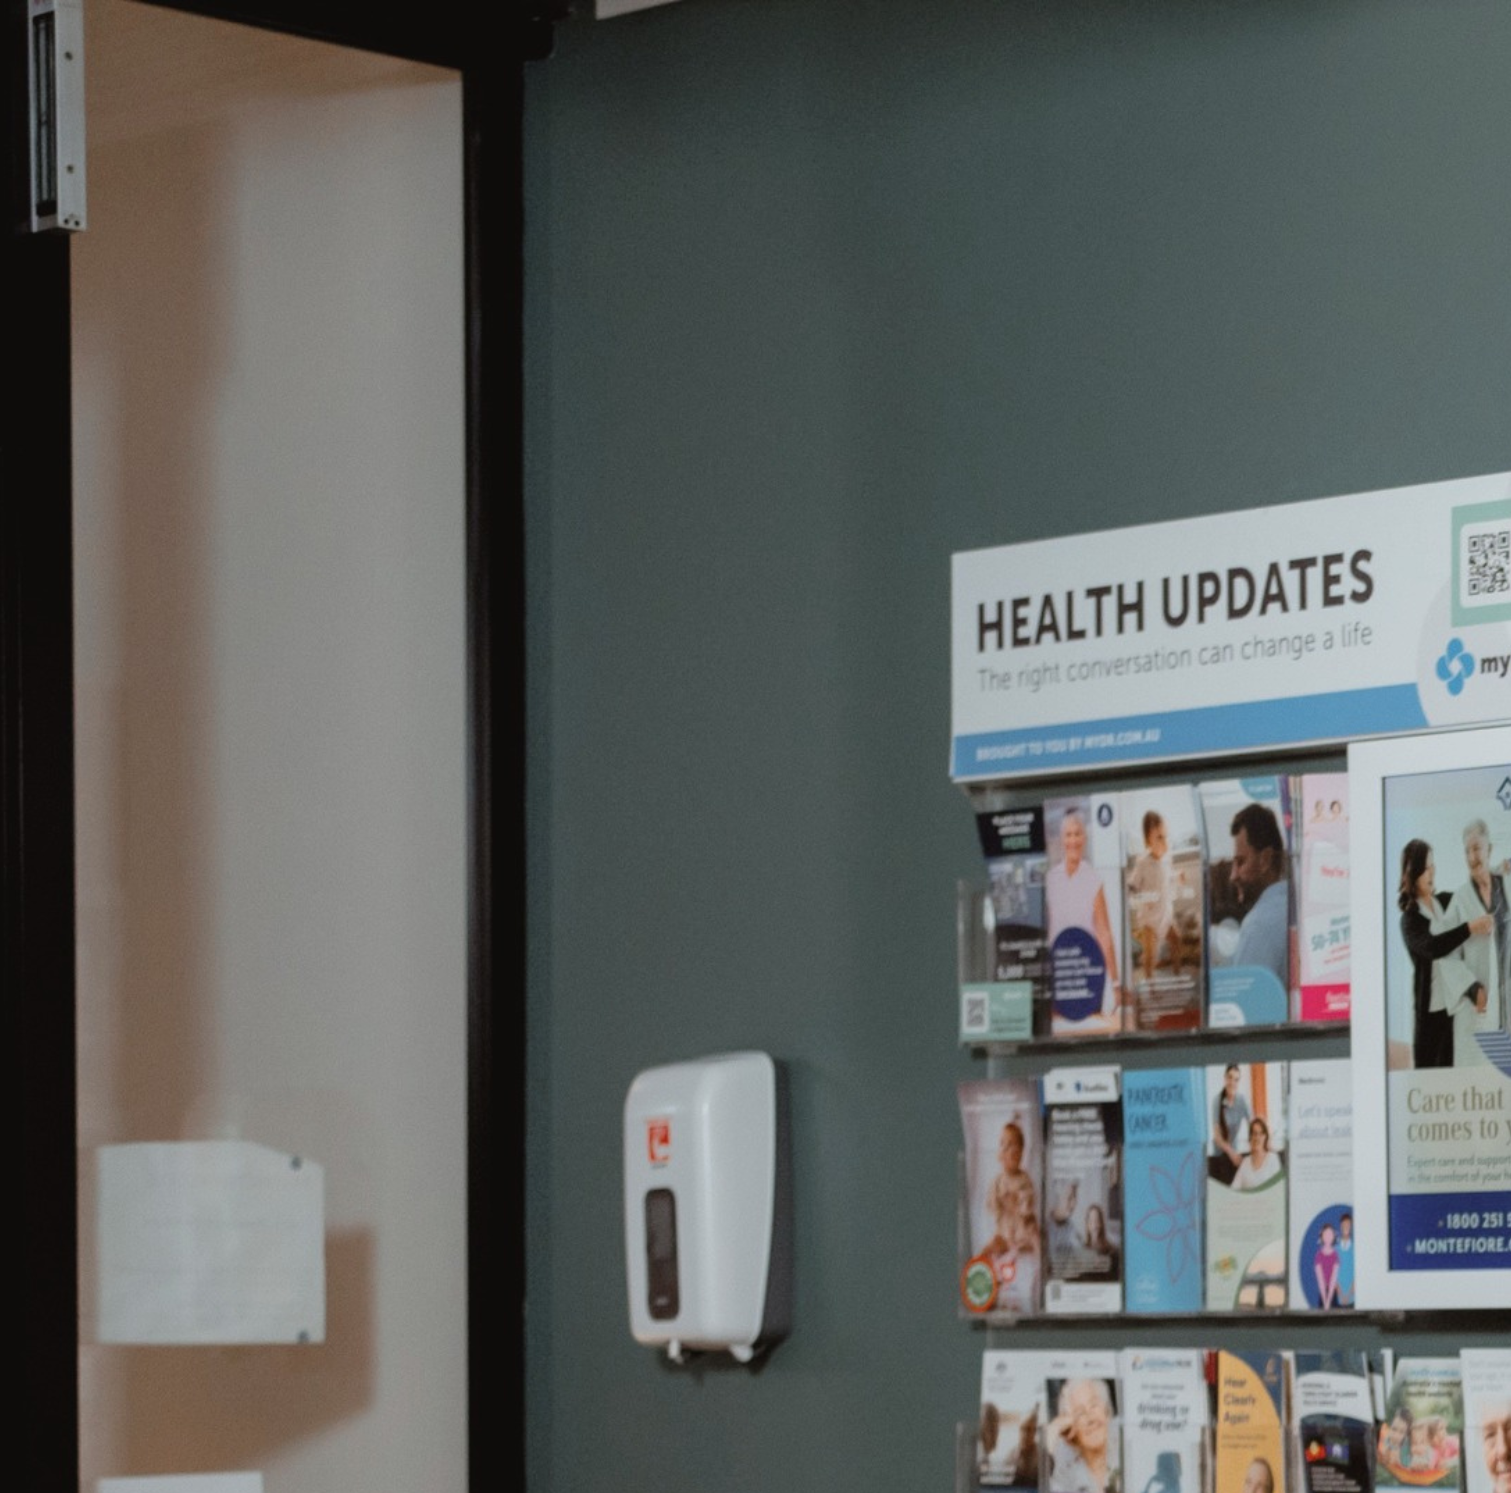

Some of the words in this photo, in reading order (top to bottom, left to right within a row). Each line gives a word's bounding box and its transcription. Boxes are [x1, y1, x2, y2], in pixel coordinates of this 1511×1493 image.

[977, 580, 1146, 653] HEALTH
[1161, 548, 1374, 628] UPDATES
[978, 667, 1012, 693] The
[1016, 661, 1061, 694] right
[1066, 645, 1191, 683] conversation
[1198, 642, 1234, 666] can
[1240, 628, 1316, 661] change
[1322, 629, 1334, 651] a
[1341, 620, 1373, 648] life
[1028, 741, 1043, 756] TO
[1407, 1087, 1455, 1114] Care
[1462, 1084, 1504, 1112] that
[1407, 1119, 1472, 1143] comes
[1480, 1117, 1499, 1139] to
[1407, 1155, 1436, 1171] Expert
[1438, 1157, 1456, 1168] care
[1458, 1155, 1475, 1167] and
[1477, 1155, 1511, 1169] support
[1482, 1171, 1502, 1185] your
[1447, 1213, 1479, 1229] 1800
[1482, 1212, 1503, 1228] 251
